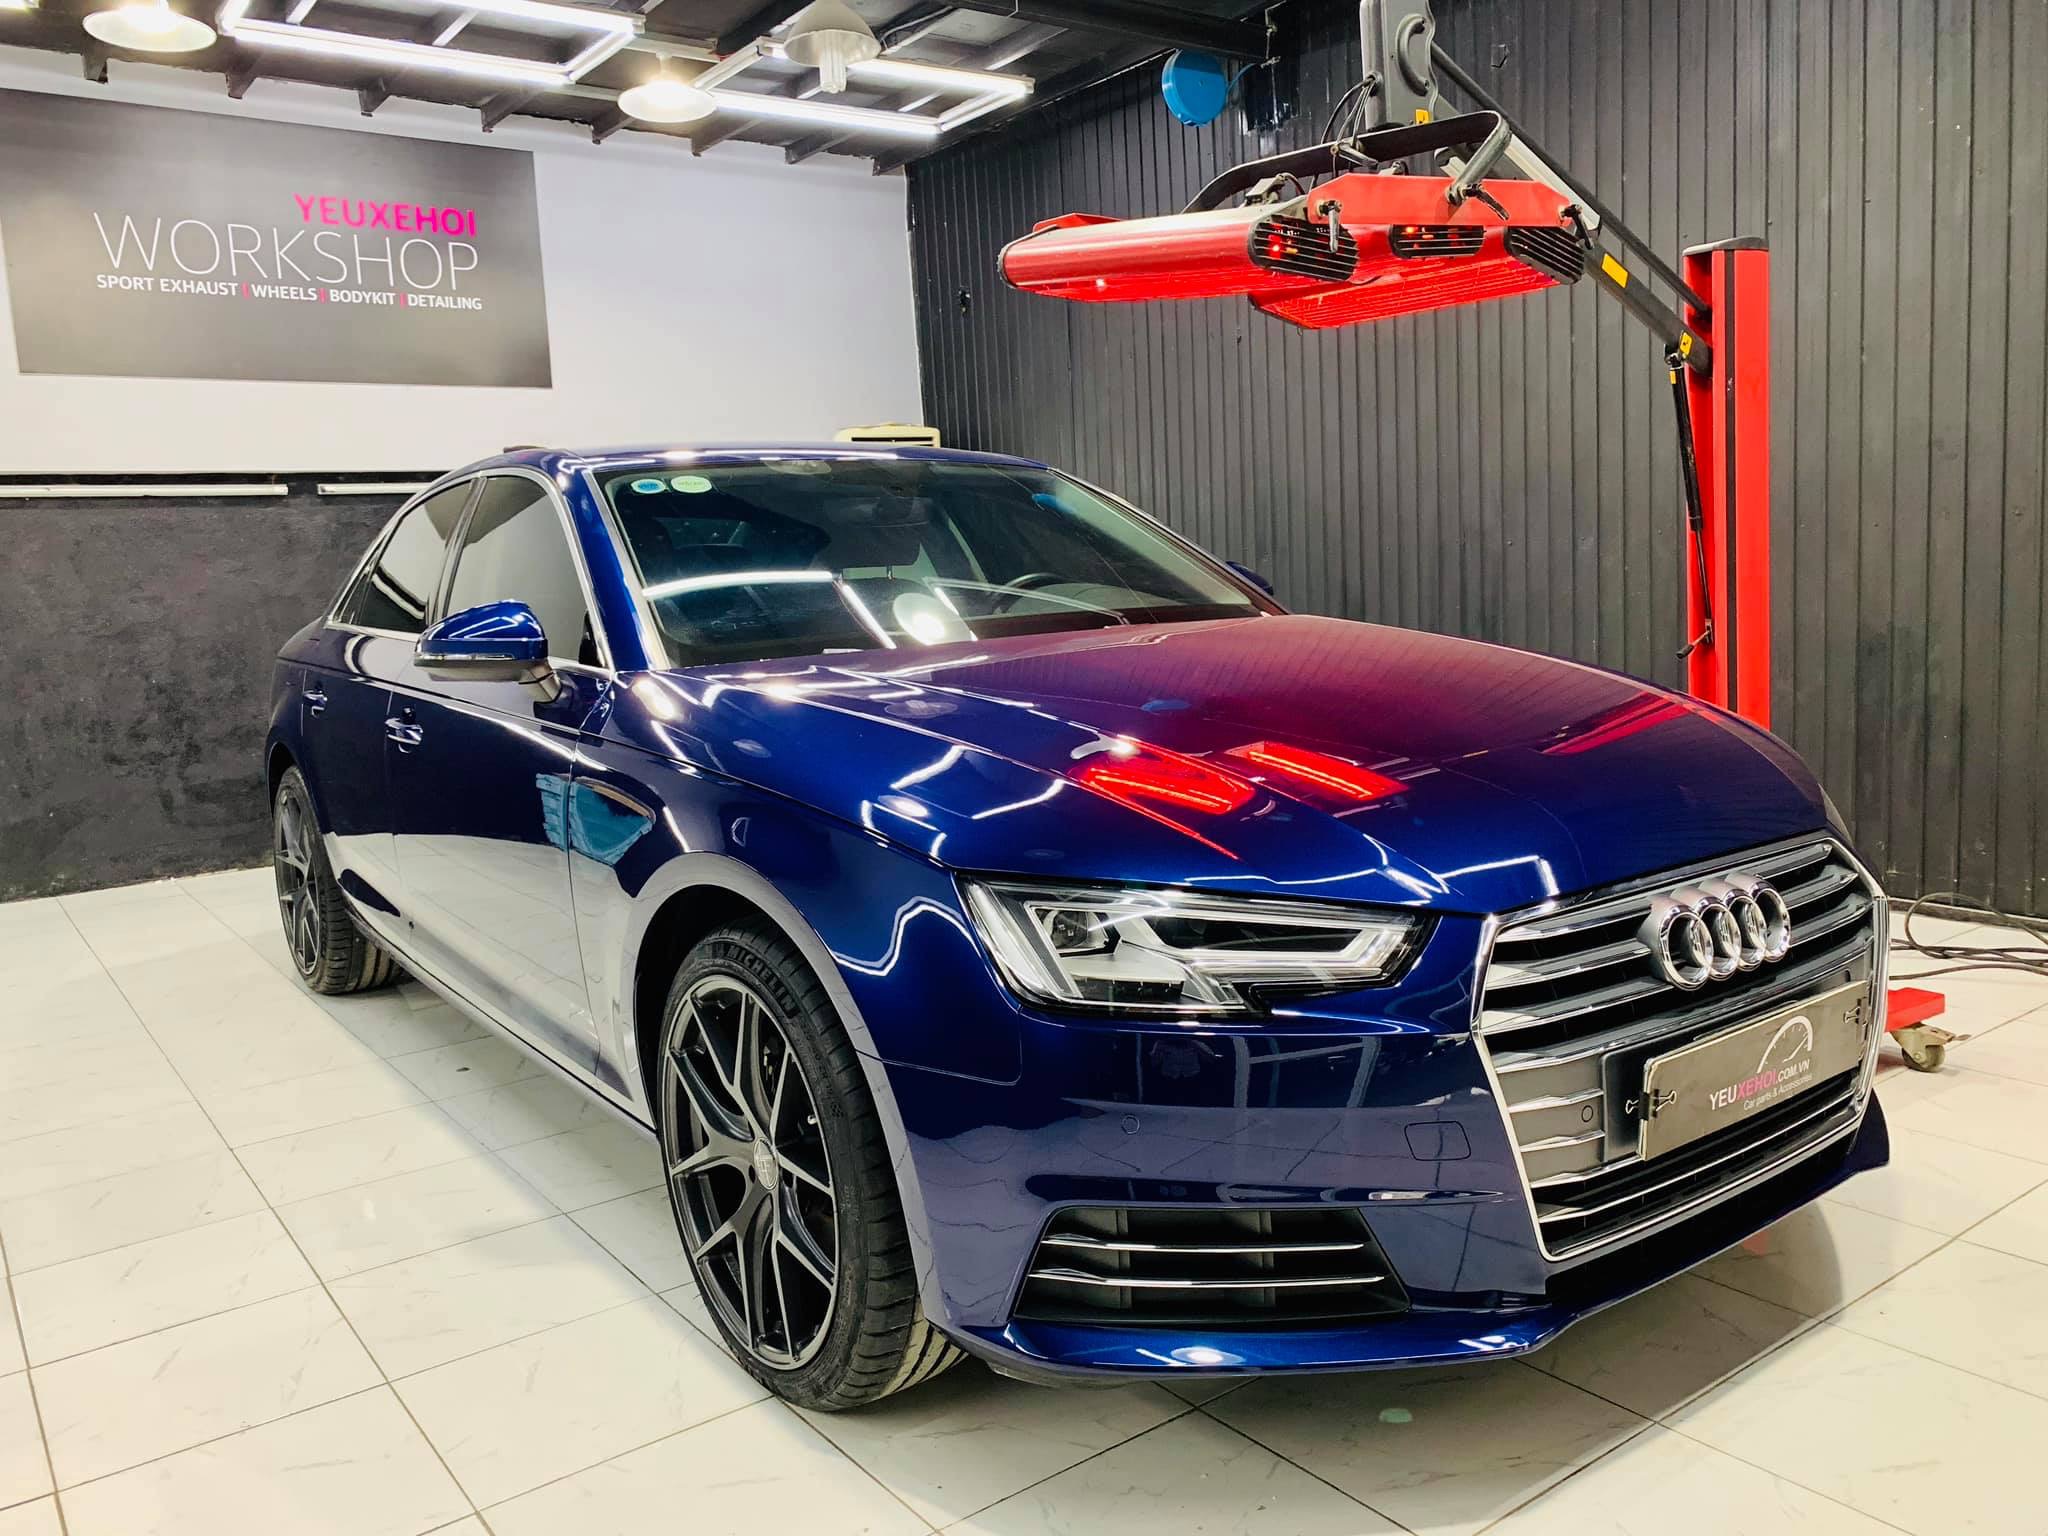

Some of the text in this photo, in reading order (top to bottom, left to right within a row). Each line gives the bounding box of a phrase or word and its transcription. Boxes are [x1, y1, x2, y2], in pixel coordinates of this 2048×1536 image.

[293, 193, 476, 237] YEUXEHOI
[93, 212, 478, 290] WORKSHOP
[97, 274, 482, 310] SPORT EXHAUST WHEELS BODYKIT DETAILING
[727, 944, 797, 1013] MICHELIN
